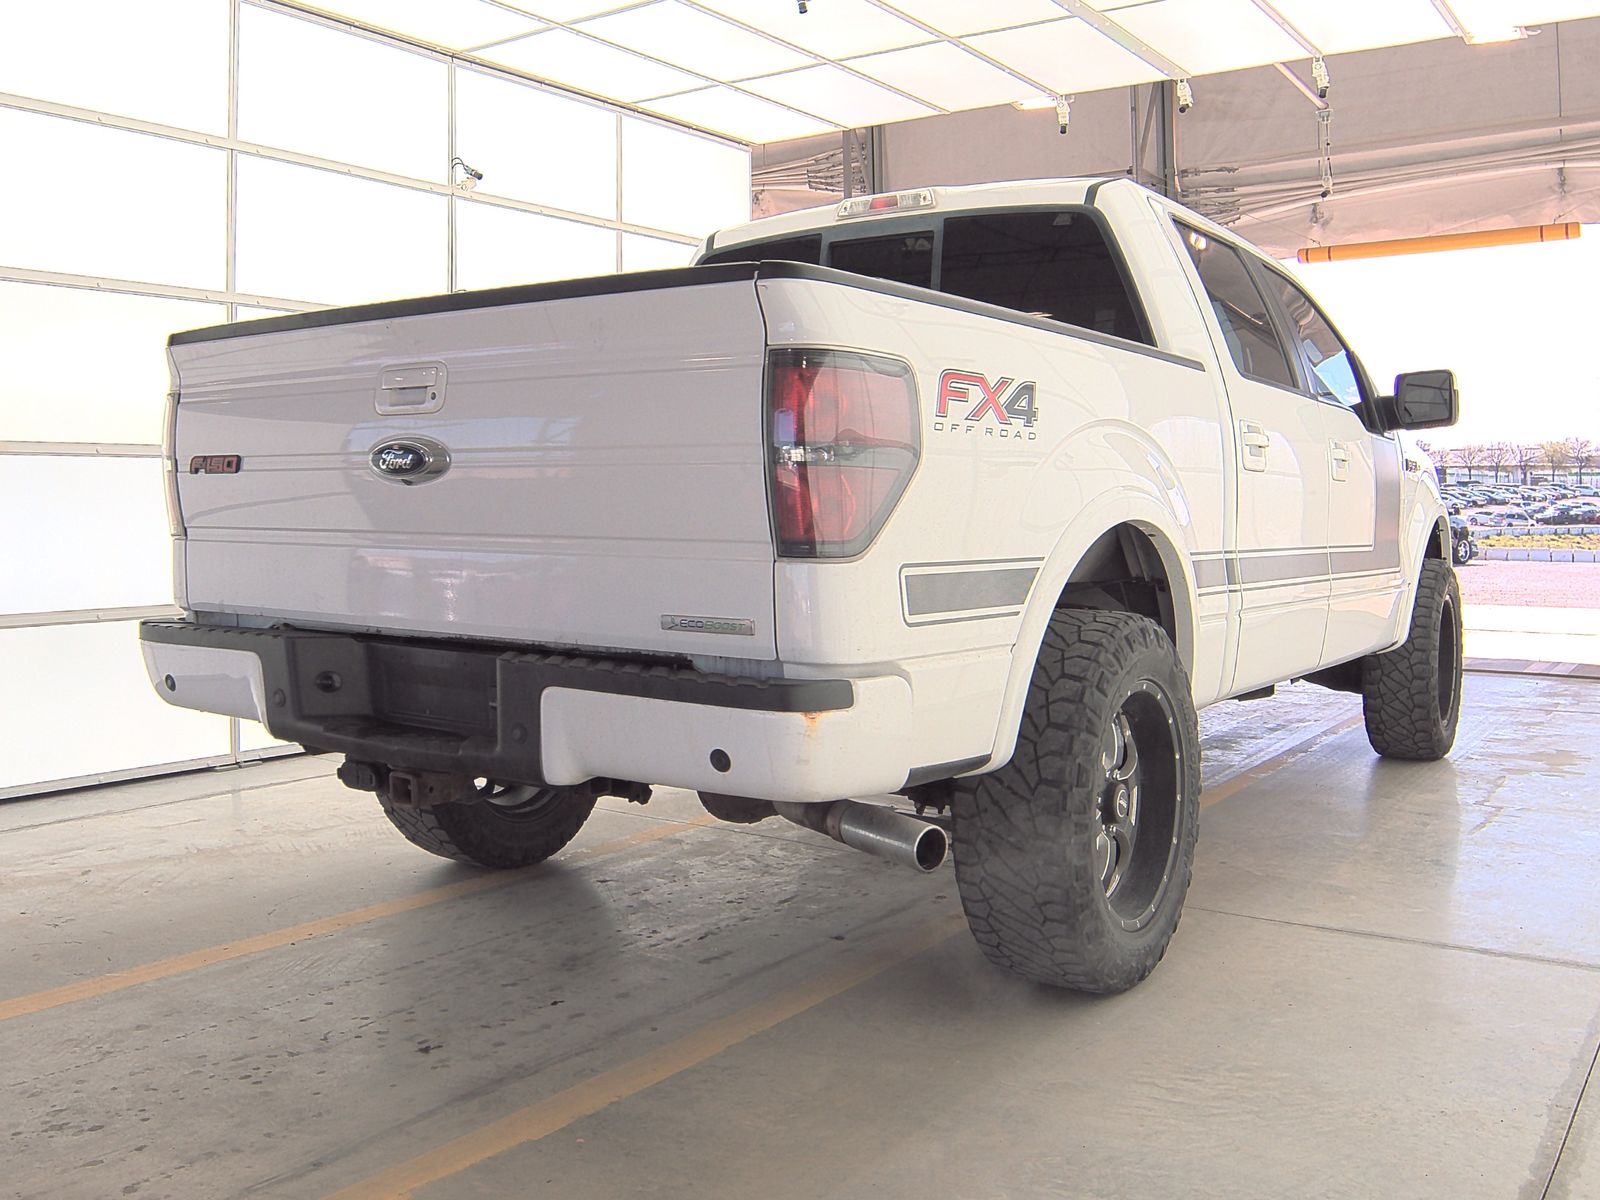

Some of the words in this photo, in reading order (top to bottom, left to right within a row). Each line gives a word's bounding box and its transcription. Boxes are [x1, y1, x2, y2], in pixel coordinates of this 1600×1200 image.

[935, 368, 1038, 427] FX4
[933, 422, 976, 434] OFF
[984, 427, 1037, 440] ROAD
[379, 449, 413, 469] Ford
